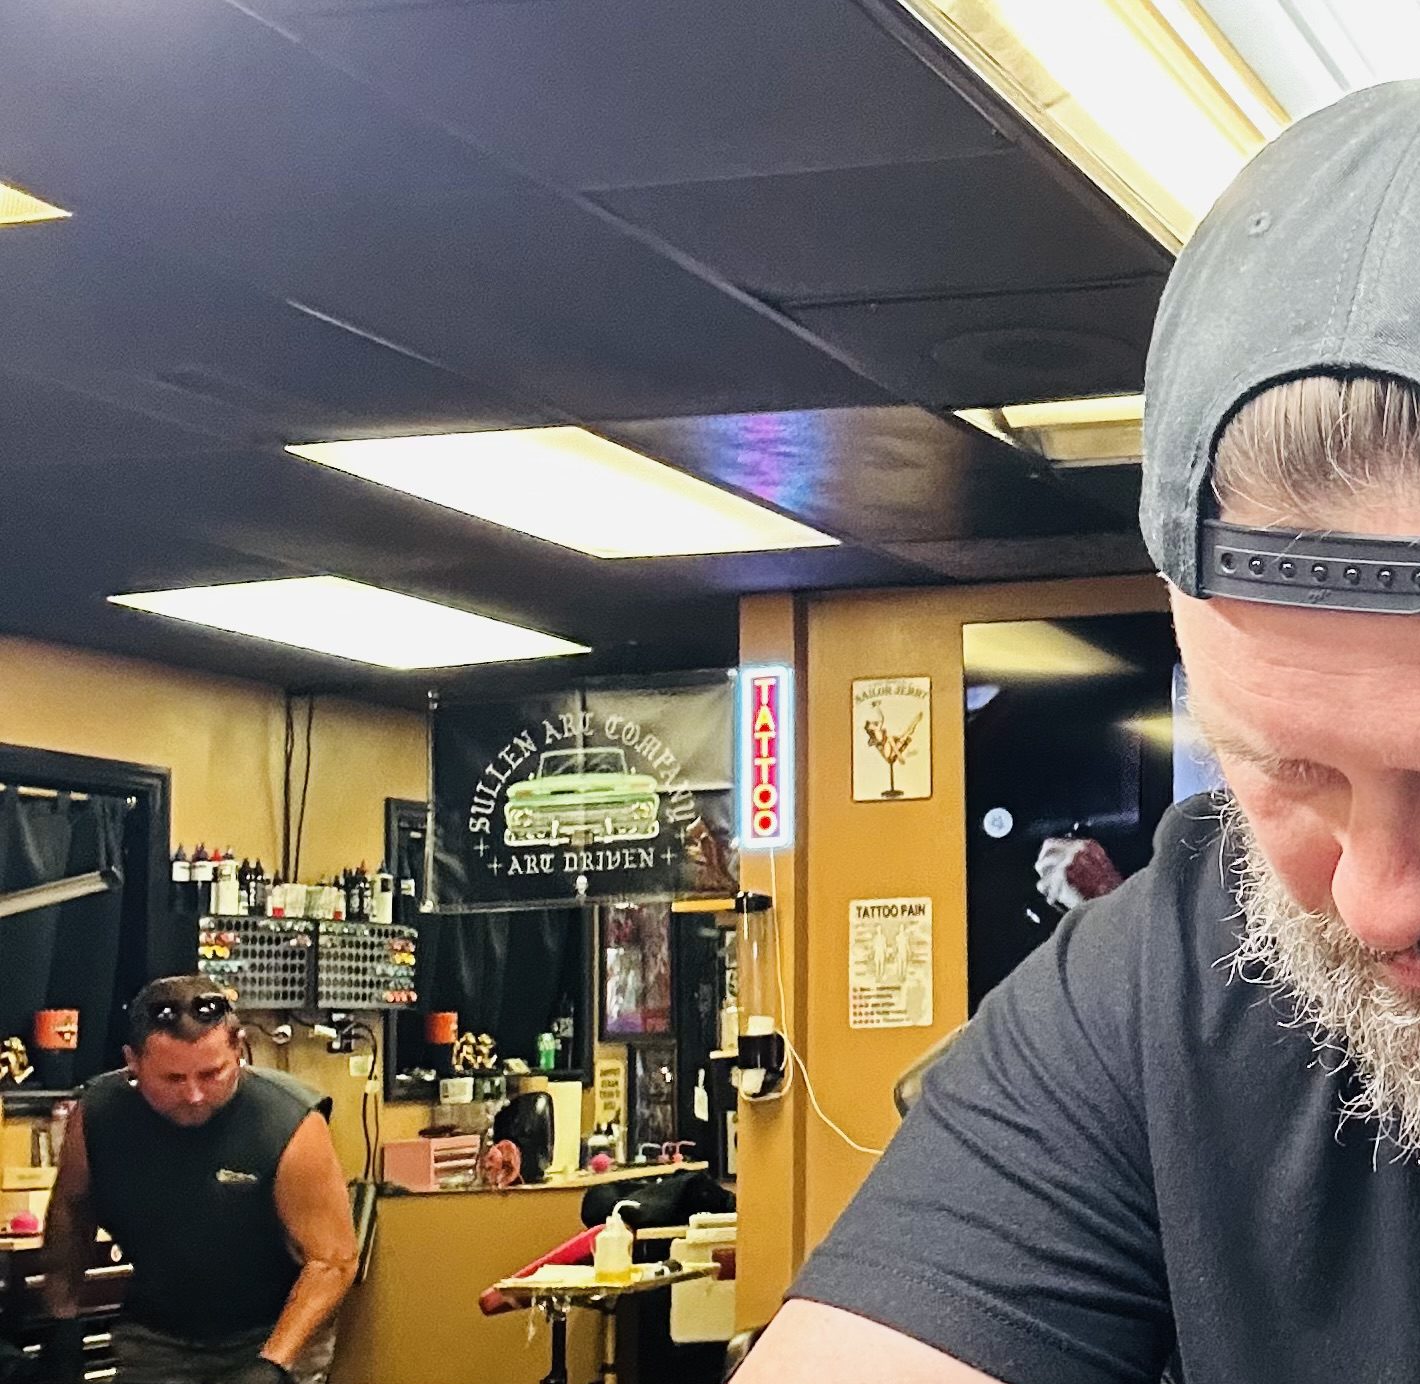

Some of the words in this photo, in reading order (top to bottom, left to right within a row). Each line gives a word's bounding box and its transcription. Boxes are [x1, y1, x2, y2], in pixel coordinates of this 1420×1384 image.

[469, 729, 538, 835] SULLEN
[542, 711, 594, 745] ART
[604, 713, 697, 824] COMPANY
[753, 677, 778, 837] TATTOO
[507, 853, 555, 876] ART
[563, 847, 656, 873] DRIVEN
[856, 904, 899, 919] TATTOO
[900, 903, 926, 917] PAIN
